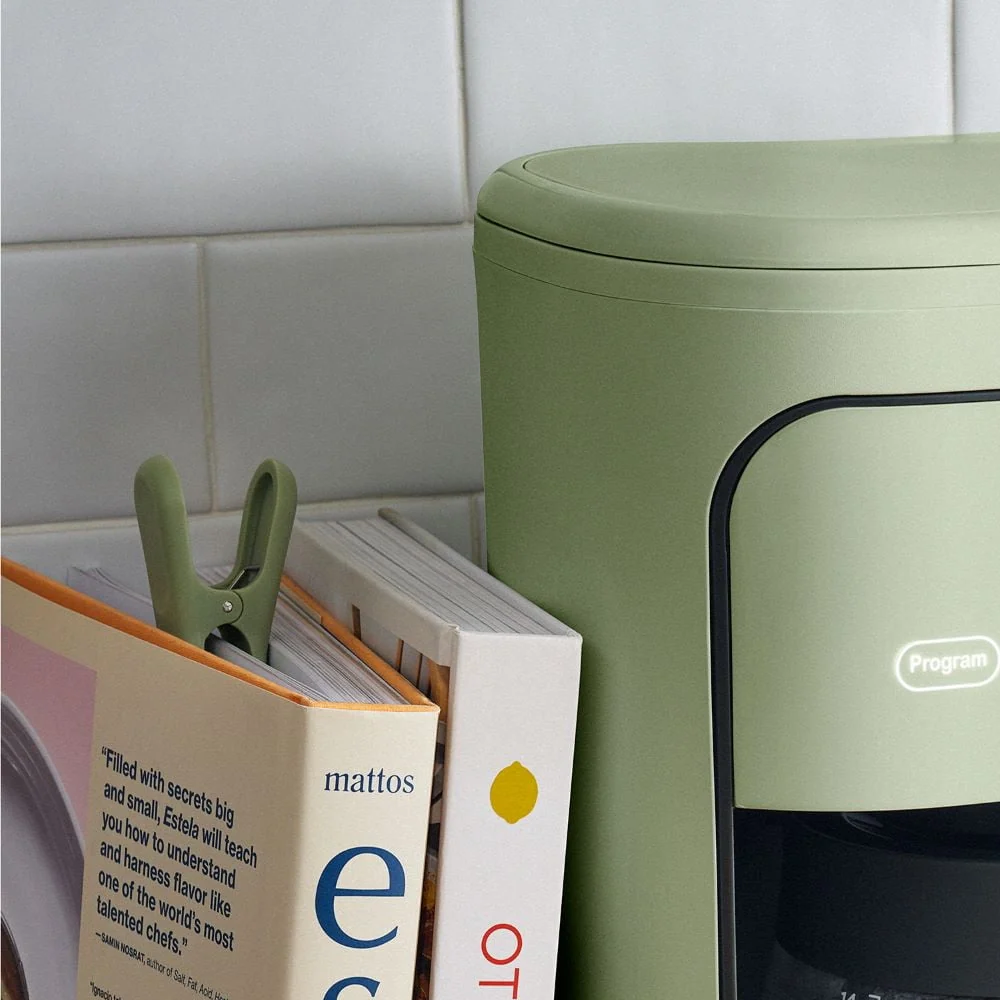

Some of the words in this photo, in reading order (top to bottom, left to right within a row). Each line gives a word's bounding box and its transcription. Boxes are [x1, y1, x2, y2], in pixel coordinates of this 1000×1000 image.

[909, 649, 988, 675] Program
[140, 768, 165, 793] with
[167, 781, 213, 815] secrets
[215, 797, 234, 829] big
[324, 770, 415, 795] mattos
[102, 811, 122, 835] you
[125, 817, 150, 847] how
[152, 832, 164, 854] to
[167, 842, 236, 889] understand
[104, 783, 125, 805] and
[127, 794, 160, 826] small,
[163, 805, 199, 840] Estela
[202, 827, 222, 851] will
[224, 834, 257, 868] teach
[98, 870, 119, 893] one
[122, 881, 135, 900] of
[137, 885, 156, 911] the
[159, 900, 201, 934] world’s
[204, 923, 234, 952] most
[100, 841, 122, 864] and
[124, 847, 171, 888] harness
[174, 872, 208, 906] flavor
[210, 889, 231, 918] like
[97, 895, 144, 936] talented
